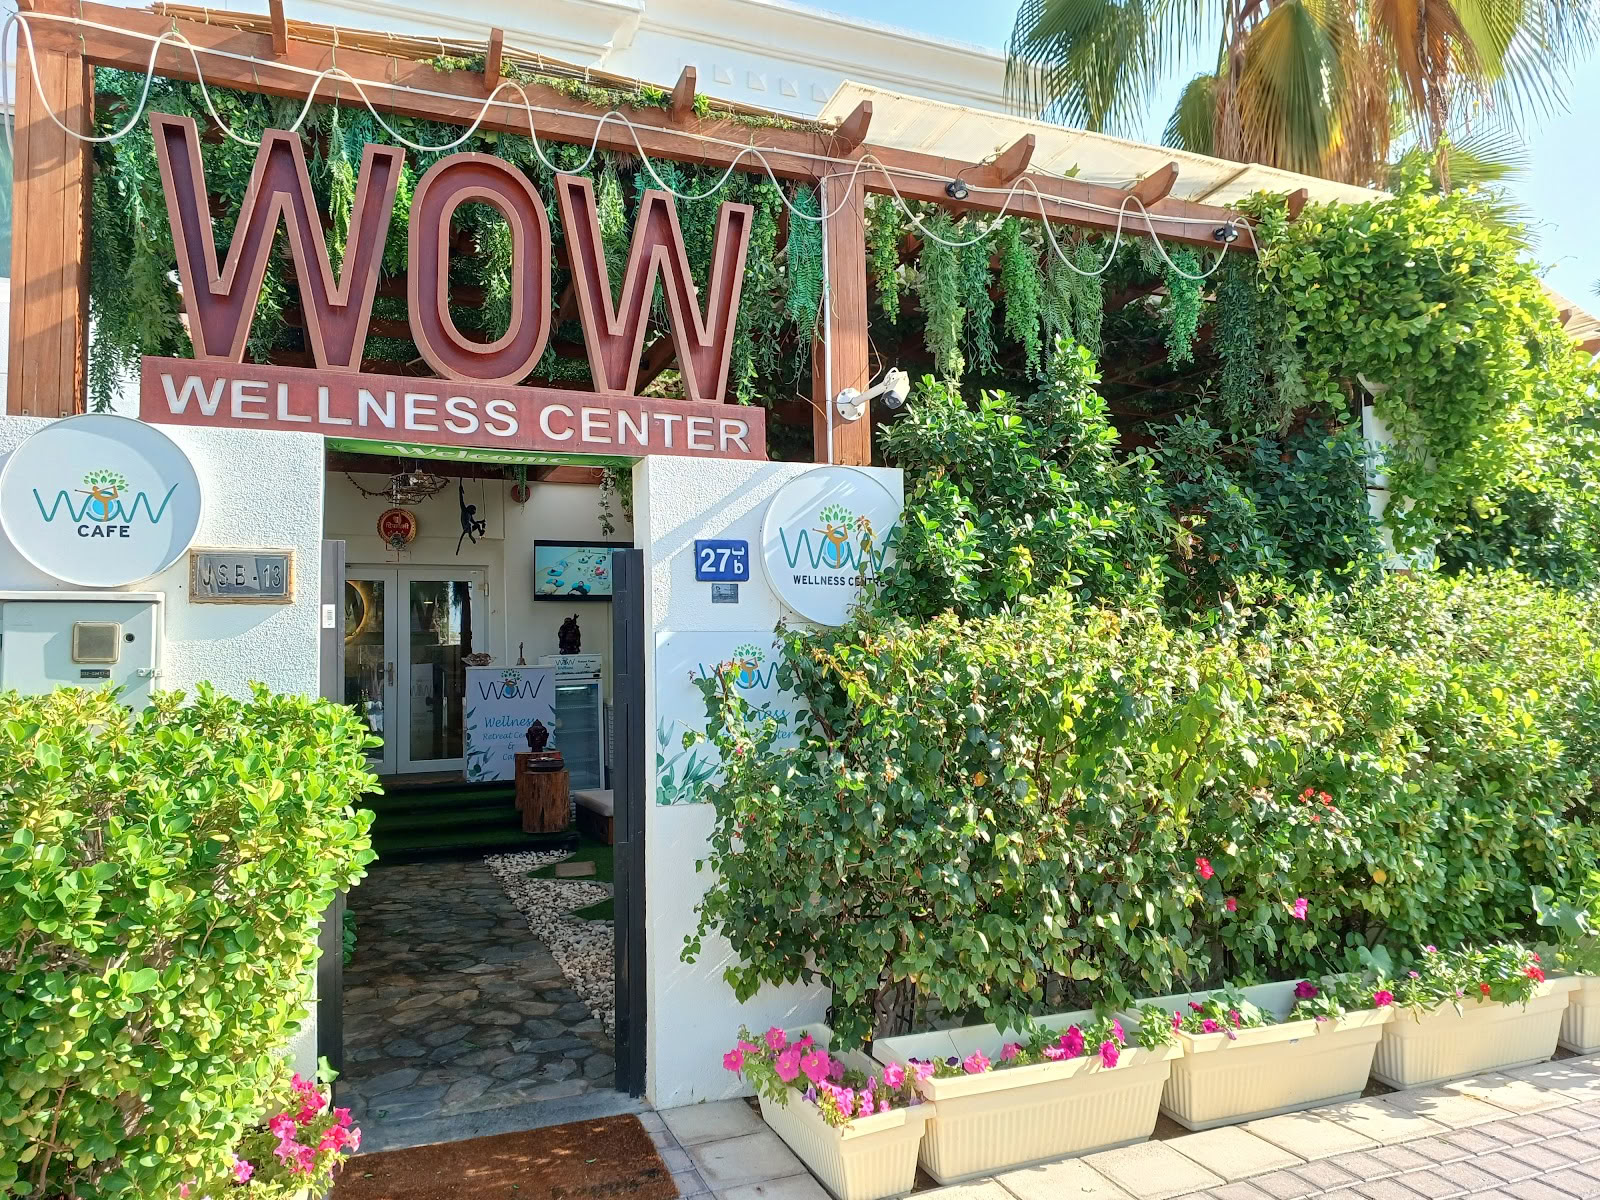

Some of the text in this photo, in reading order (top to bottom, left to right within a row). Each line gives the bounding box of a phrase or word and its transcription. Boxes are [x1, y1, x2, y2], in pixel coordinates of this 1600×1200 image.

[149, 111, 753, 403] WOW
[160, 373, 752, 453] WELLNESS CENTER
[383, 444, 570, 464] Welcome
[33, 482, 180, 524] WOW
[77, 524, 130, 538] CAFE
[779, 521, 898, 572] WOW
[700, 547, 731, 573] 27
[734, 559, 744, 574] b
[793, 575, 846, 587] WELLNESS
[479, 675, 546, 701] WOW
[482, 732, 512, 741] Retreat
[502, 753, 515, 761] Ca
